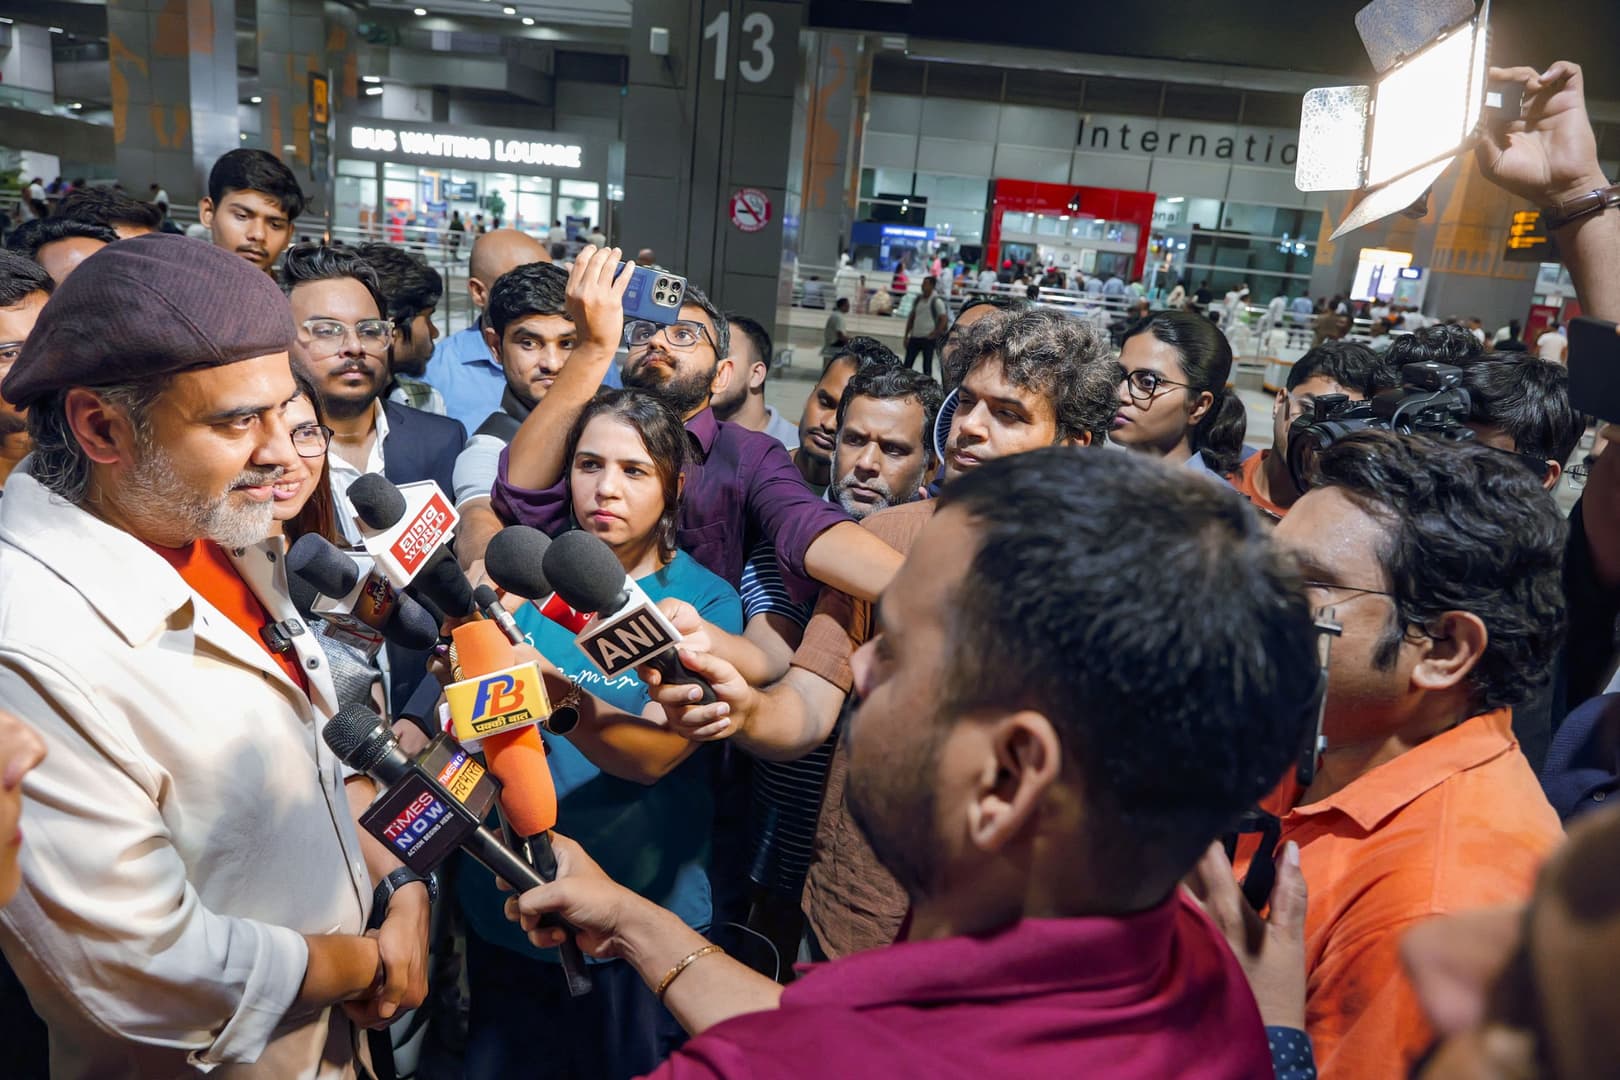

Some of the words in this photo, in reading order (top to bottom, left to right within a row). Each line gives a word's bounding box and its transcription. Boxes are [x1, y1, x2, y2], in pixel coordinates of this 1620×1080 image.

[703, 10, 775, 83] 13
[351, 126, 397, 152] BUS
[400, 131, 491, 160] WAITING
[494, 139, 582, 168] LOUNGE
[400, 506, 437, 552] abc
[403, 511, 448, 561] WORLD
[595, 613, 665, 669] ANI
[471, 674, 525, 721] PB
[475, 715, 507, 732] पक्की
[508, 711, 530, 723] बात
[396, 801, 444, 849] NOW
[407, 840, 426, 857] ACTION
[423, 823, 441, 841] BEGINS
[439, 811, 454, 826] HERE
